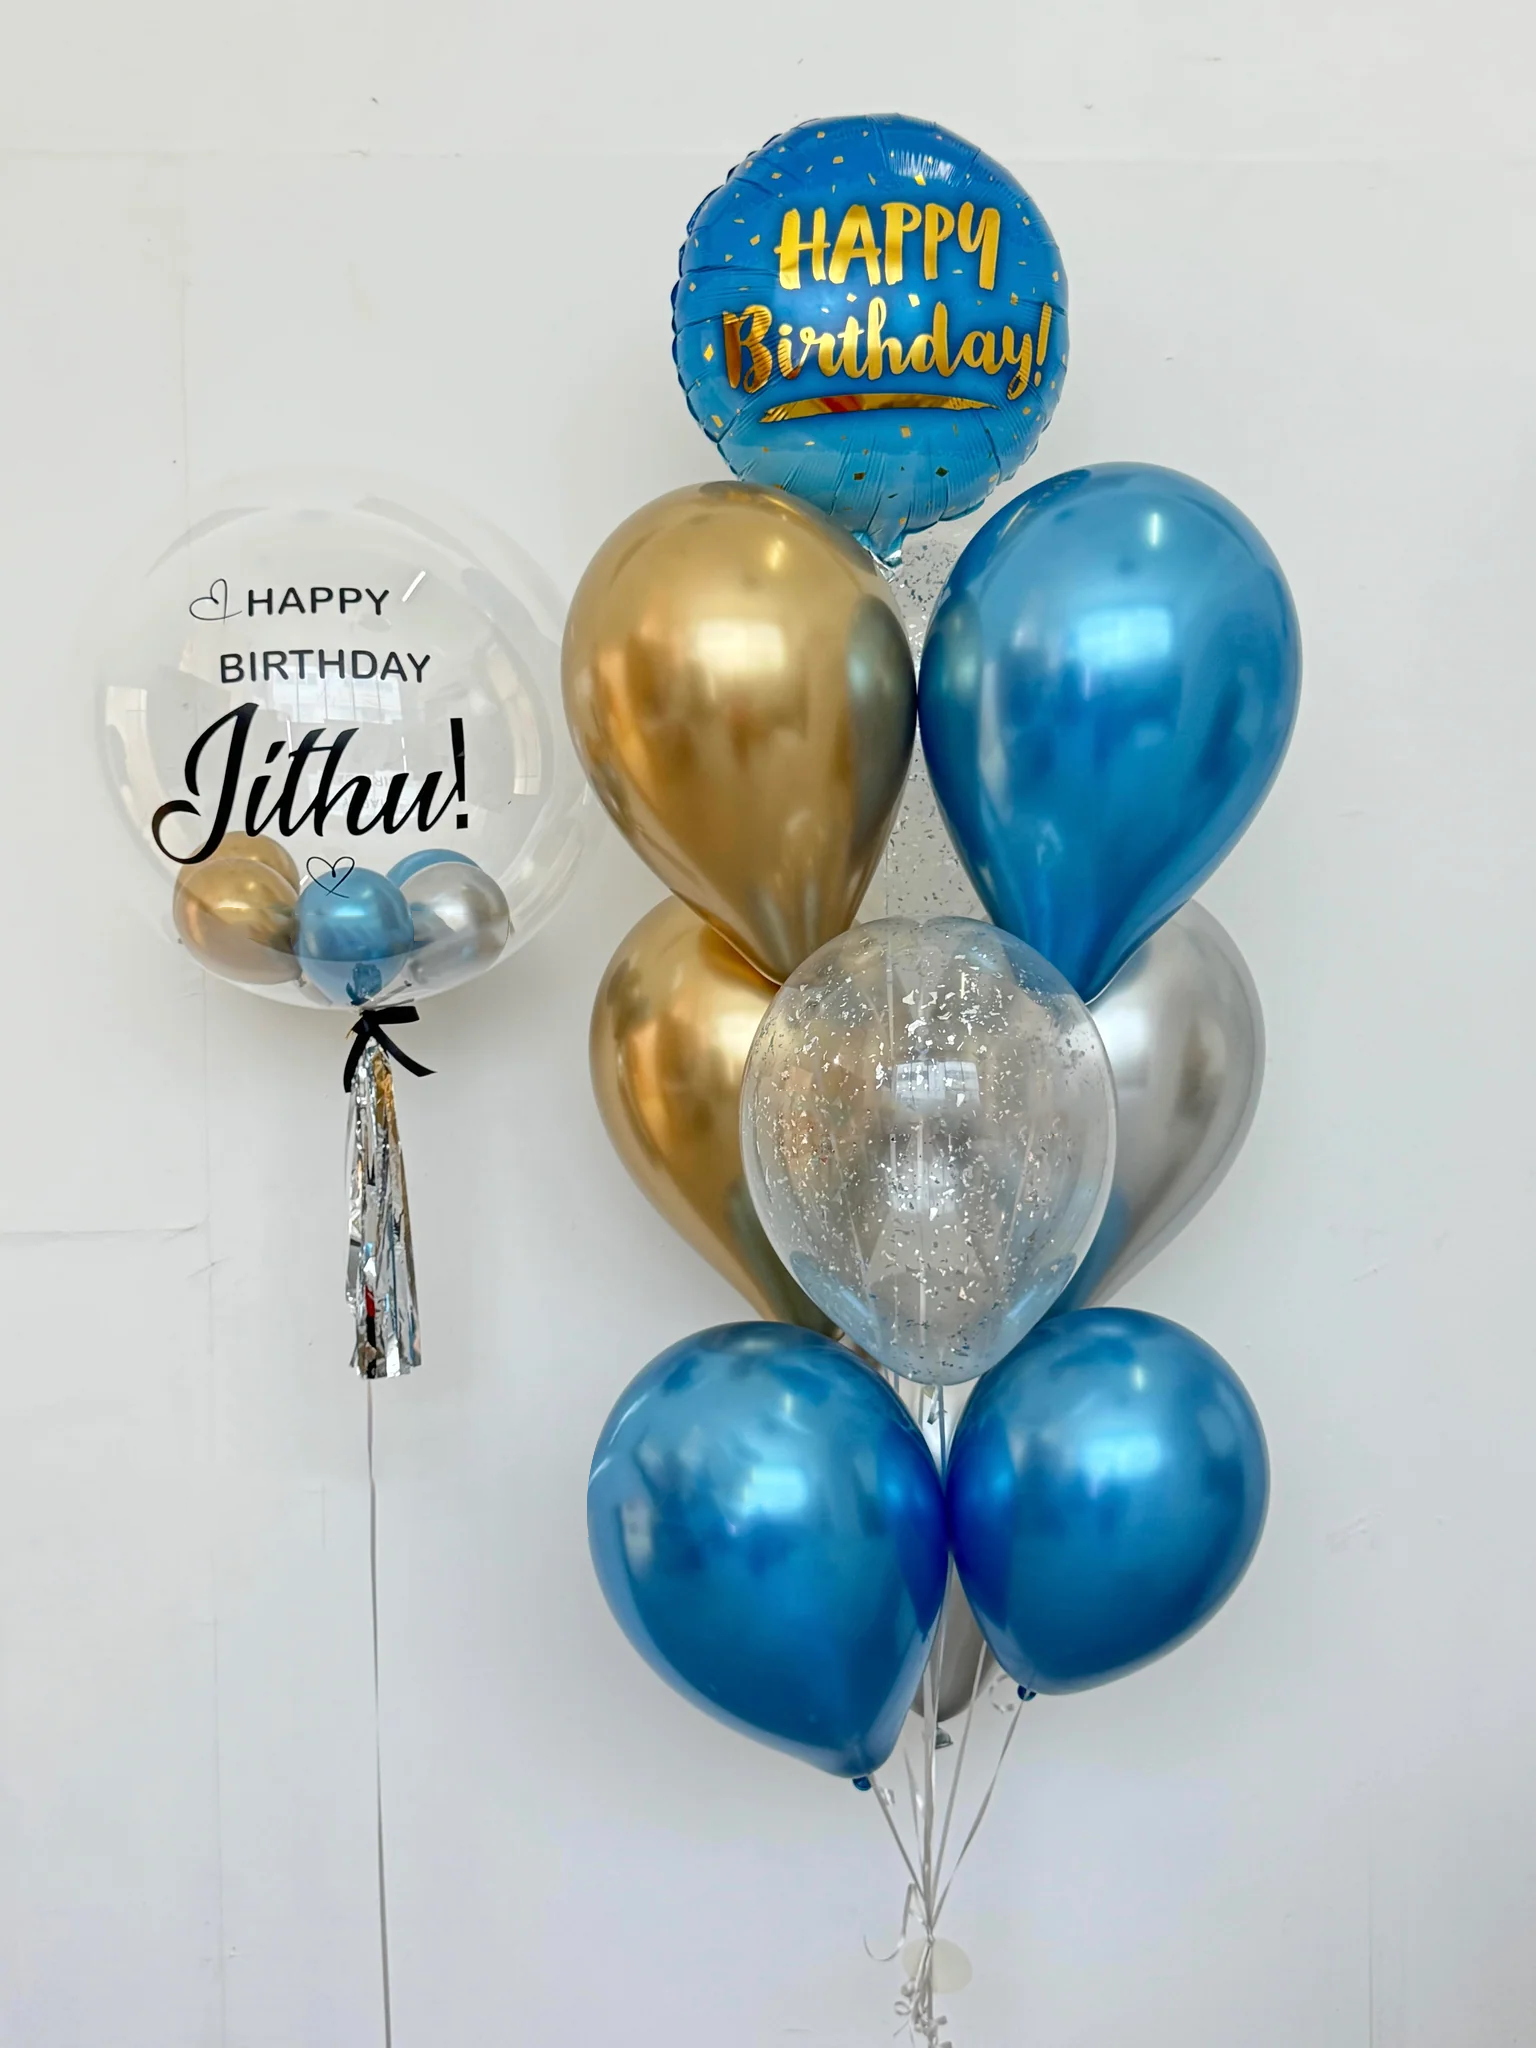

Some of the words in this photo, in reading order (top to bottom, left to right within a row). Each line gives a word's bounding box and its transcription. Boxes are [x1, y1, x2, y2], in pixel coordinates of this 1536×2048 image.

[775, 201, 1000, 290] HAPPY
[722, 297, 1052, 400] Birthday!
[248, 587, 389, 617] HAPPY
[220, 649, 431, 683] BIRTHDAY
[151, 702, 468, 864] Jithu!
